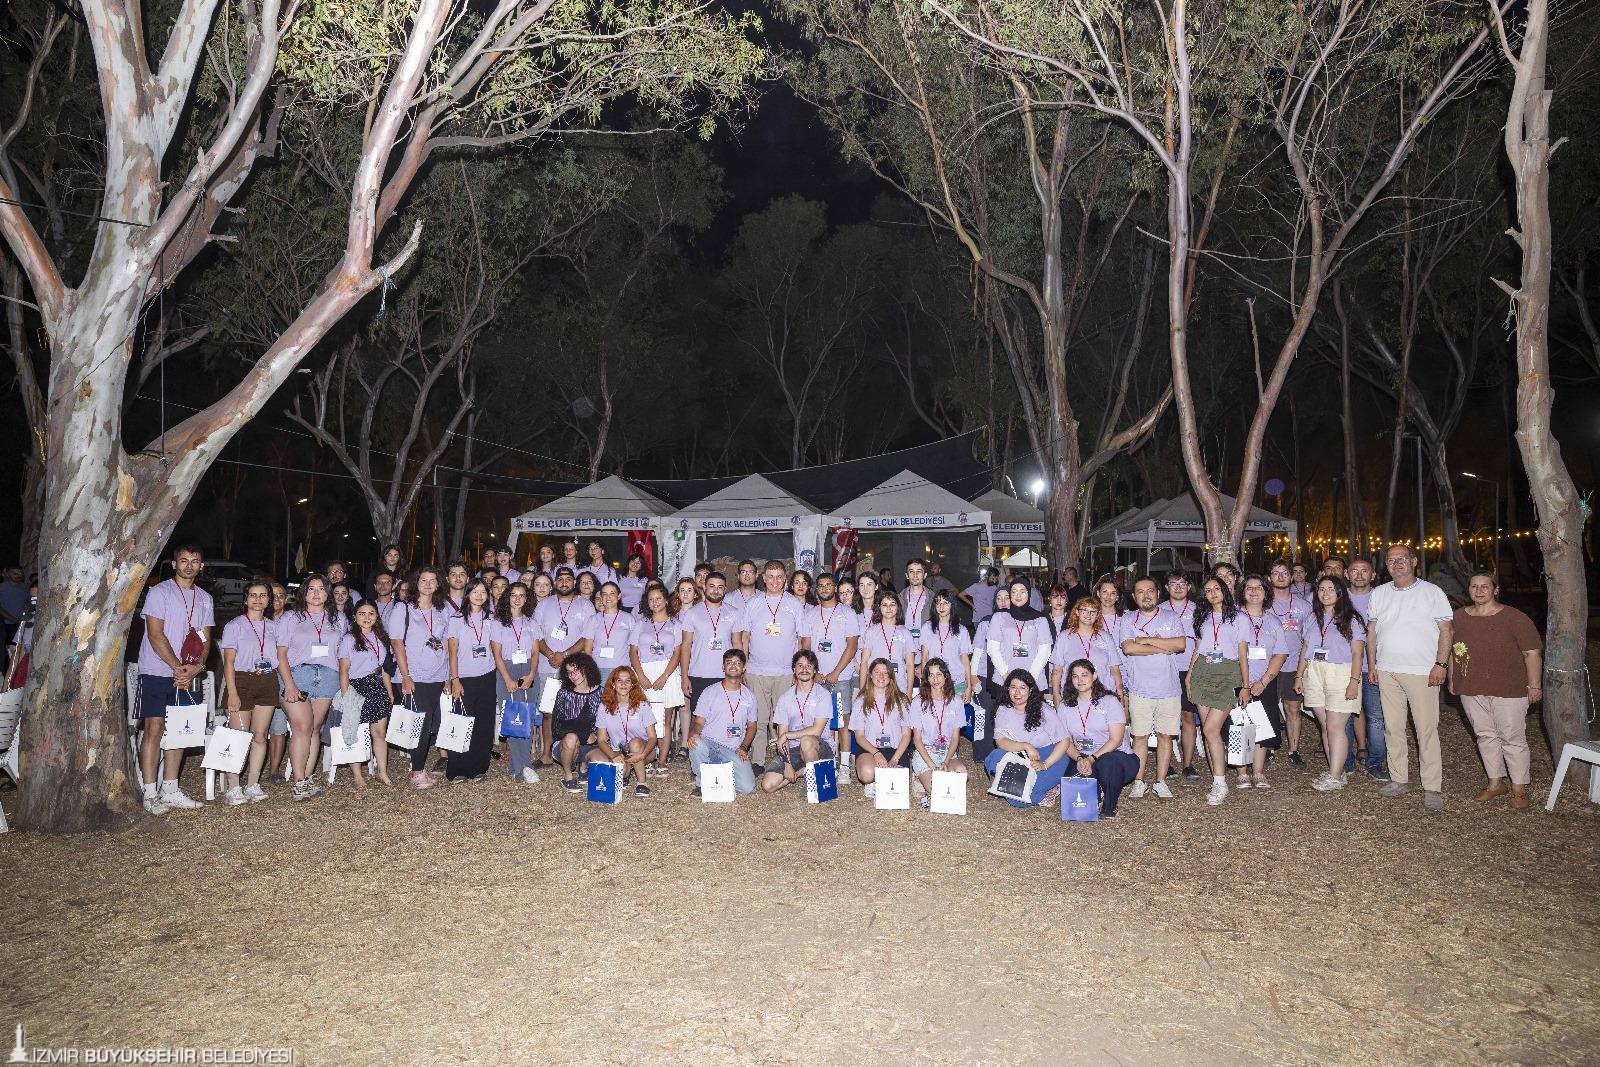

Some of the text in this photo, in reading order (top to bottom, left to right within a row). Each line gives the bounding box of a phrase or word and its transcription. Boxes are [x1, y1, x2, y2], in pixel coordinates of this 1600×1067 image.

[527, 517, 639, 529] SELÇUK BELEDİYESİ
[733, 518, 778, 528] BELEDİYESİ
[900, 515, 945, 526] BELEDİYESİ
[991, 522, 1043, 531] ELEDİYESİ
